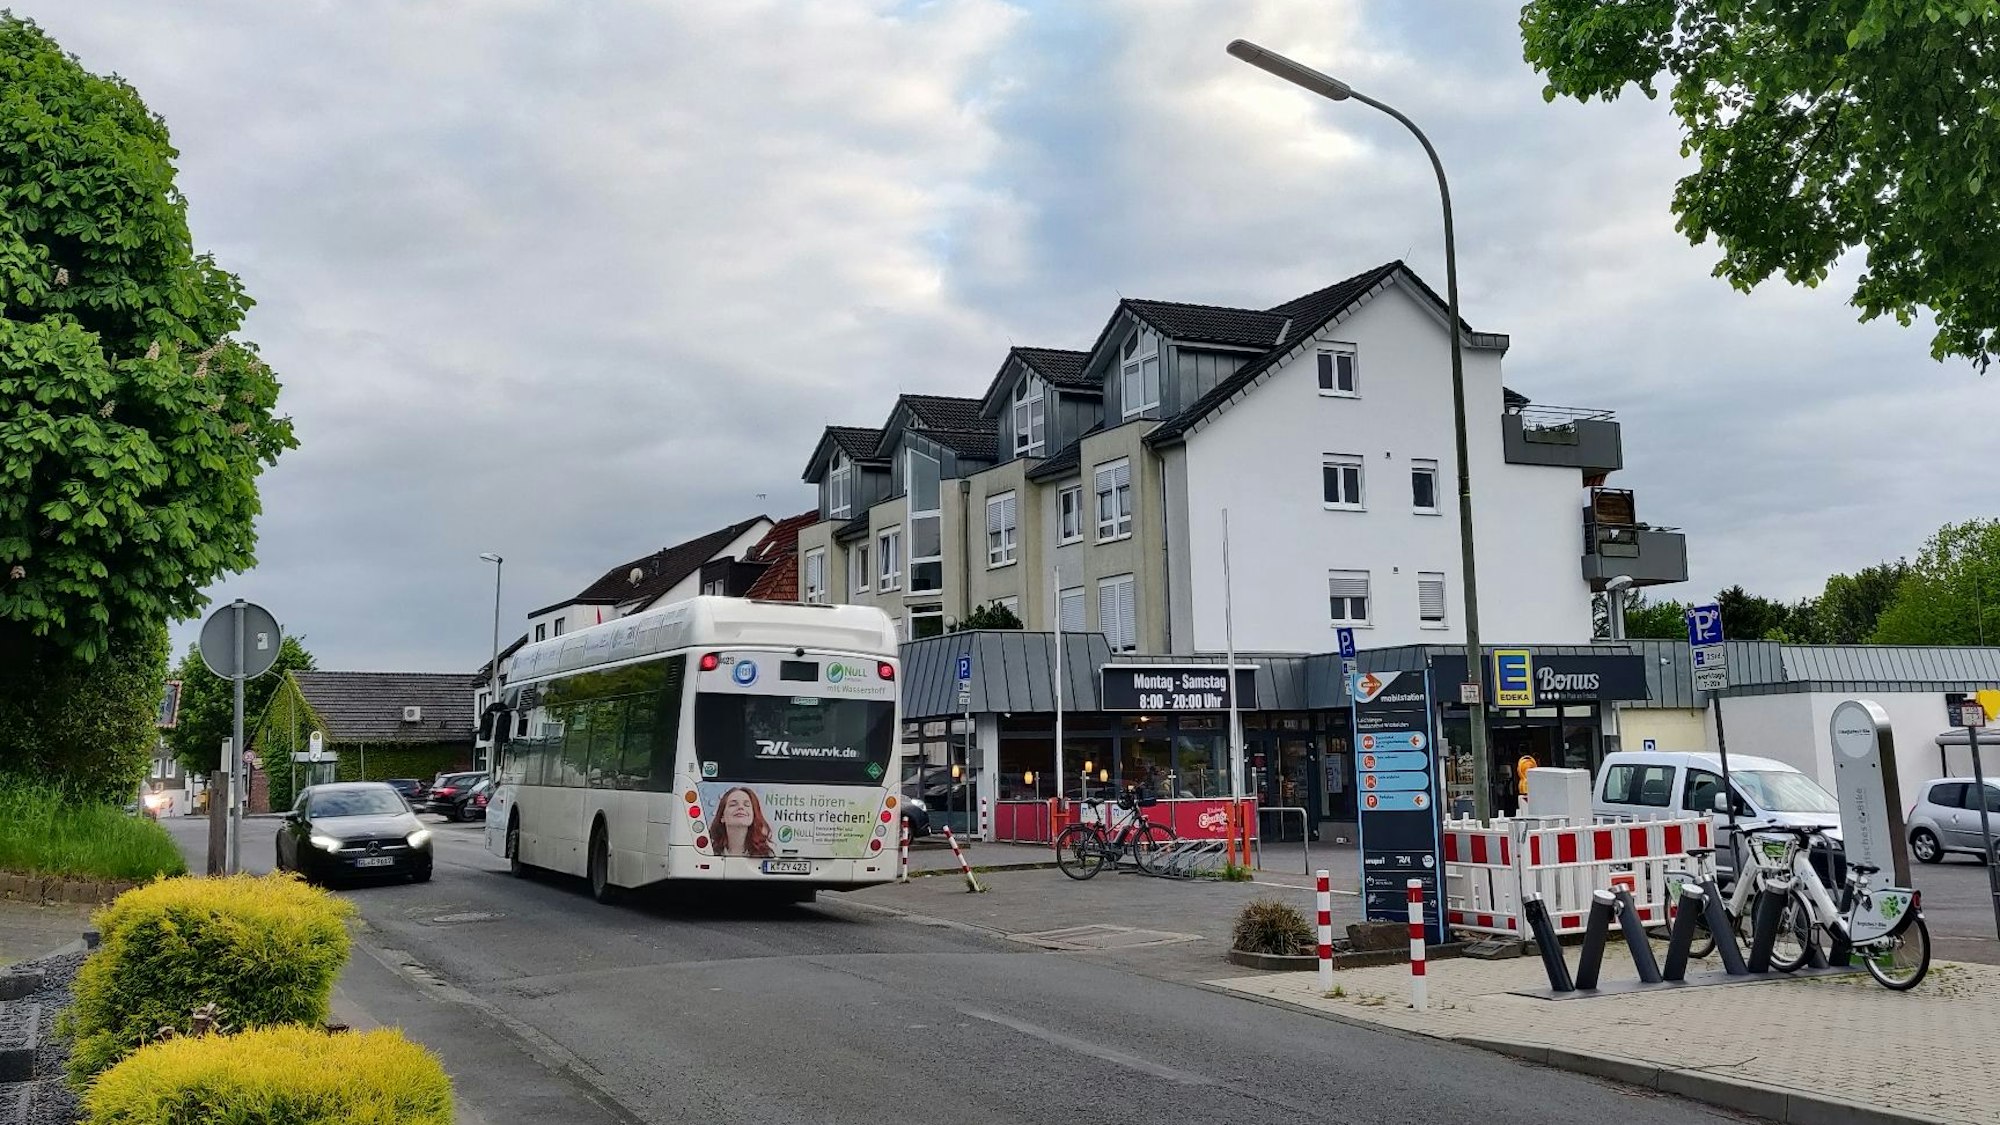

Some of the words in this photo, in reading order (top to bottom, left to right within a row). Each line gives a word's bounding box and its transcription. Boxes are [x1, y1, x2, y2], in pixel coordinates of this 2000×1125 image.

[1498, 655, 1527, 691] E
[1536, 666, 1600, 691] Bonus
[1133, 673, 1174, 692] Montag
[1182, 673, 1227, 691] Samstag
[827, 685, 842, 693] mit
[842, 685, 886, 695] Wasserstoff
[1500, 693, 1530, 701] EDEKA
[1139, 694, 1164, 709] 8:00
[1172, 694, 1203, 709] 20:00
[1203, 693, 1223, 709] Uhr
[1380, 693, 1425, 702] mobilstation
[791, 746, 857, 758] www.rvk.de
[765, 793, 805, 806] Nichts
[810, 794, 845, 807] hören
[774, 810, 815, 823] Nichts
[818, 811, 871, 824] riechen!
[770, 863, 776, 871] K
[781, 863, 791, 871] ZY
